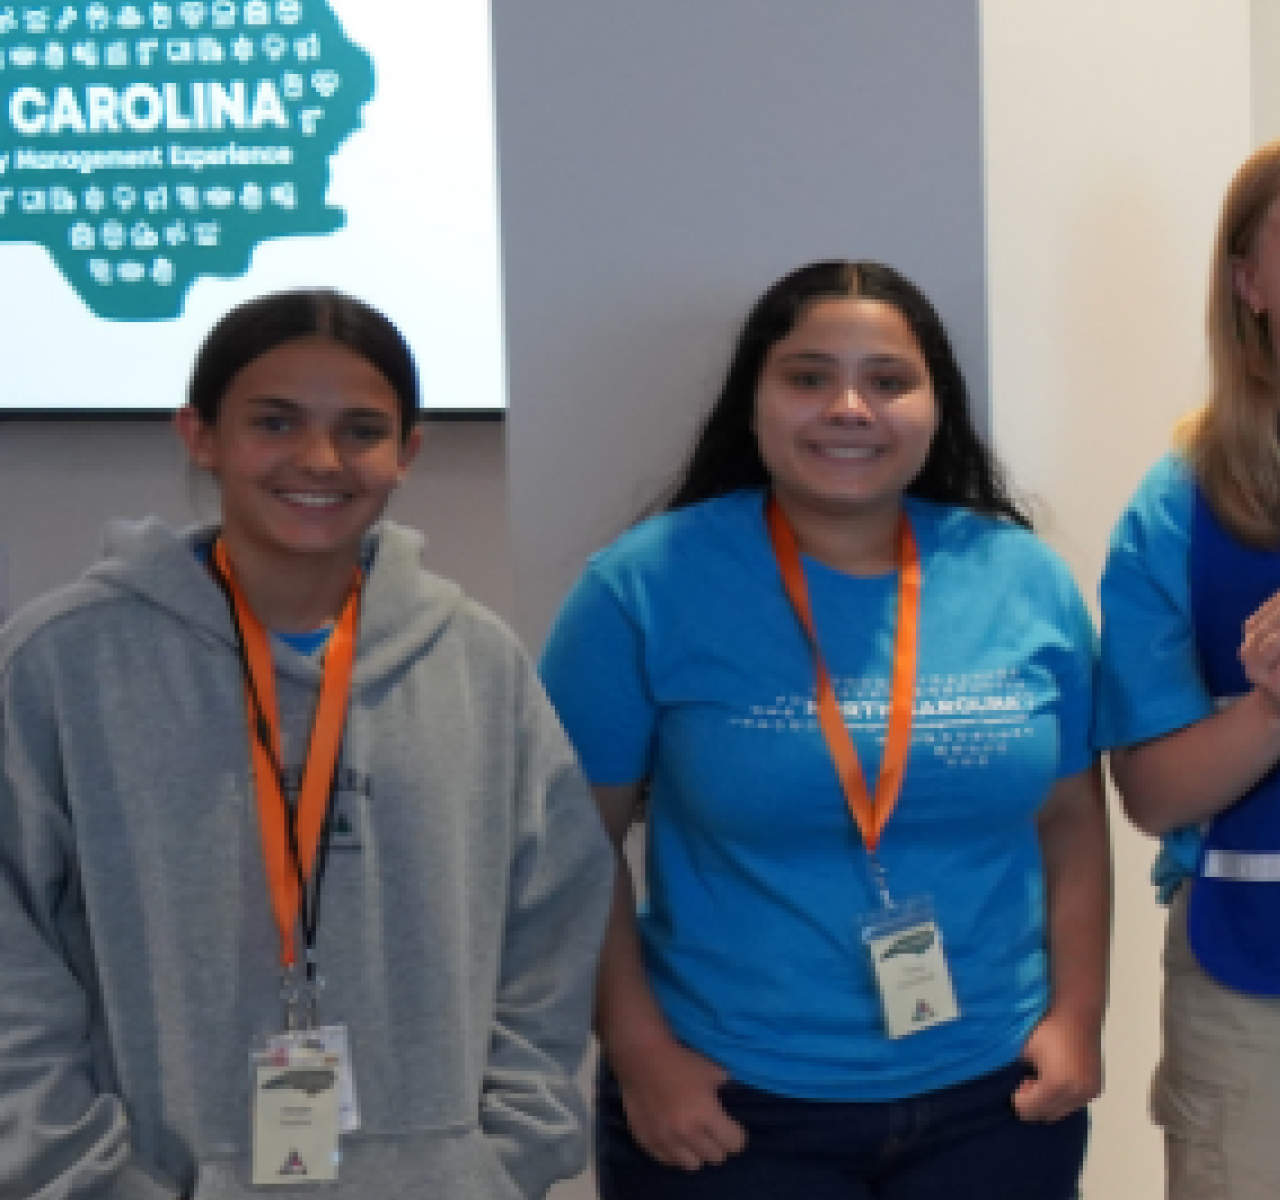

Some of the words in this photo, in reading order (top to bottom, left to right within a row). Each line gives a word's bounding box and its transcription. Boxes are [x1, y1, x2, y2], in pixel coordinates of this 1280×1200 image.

[9, 80, 290, 134] CAROLINA
[14, 146, 163, 173] Management
[168, 142, 294, 173] Experience
[905, 696, 1021, 716] AROLINA
